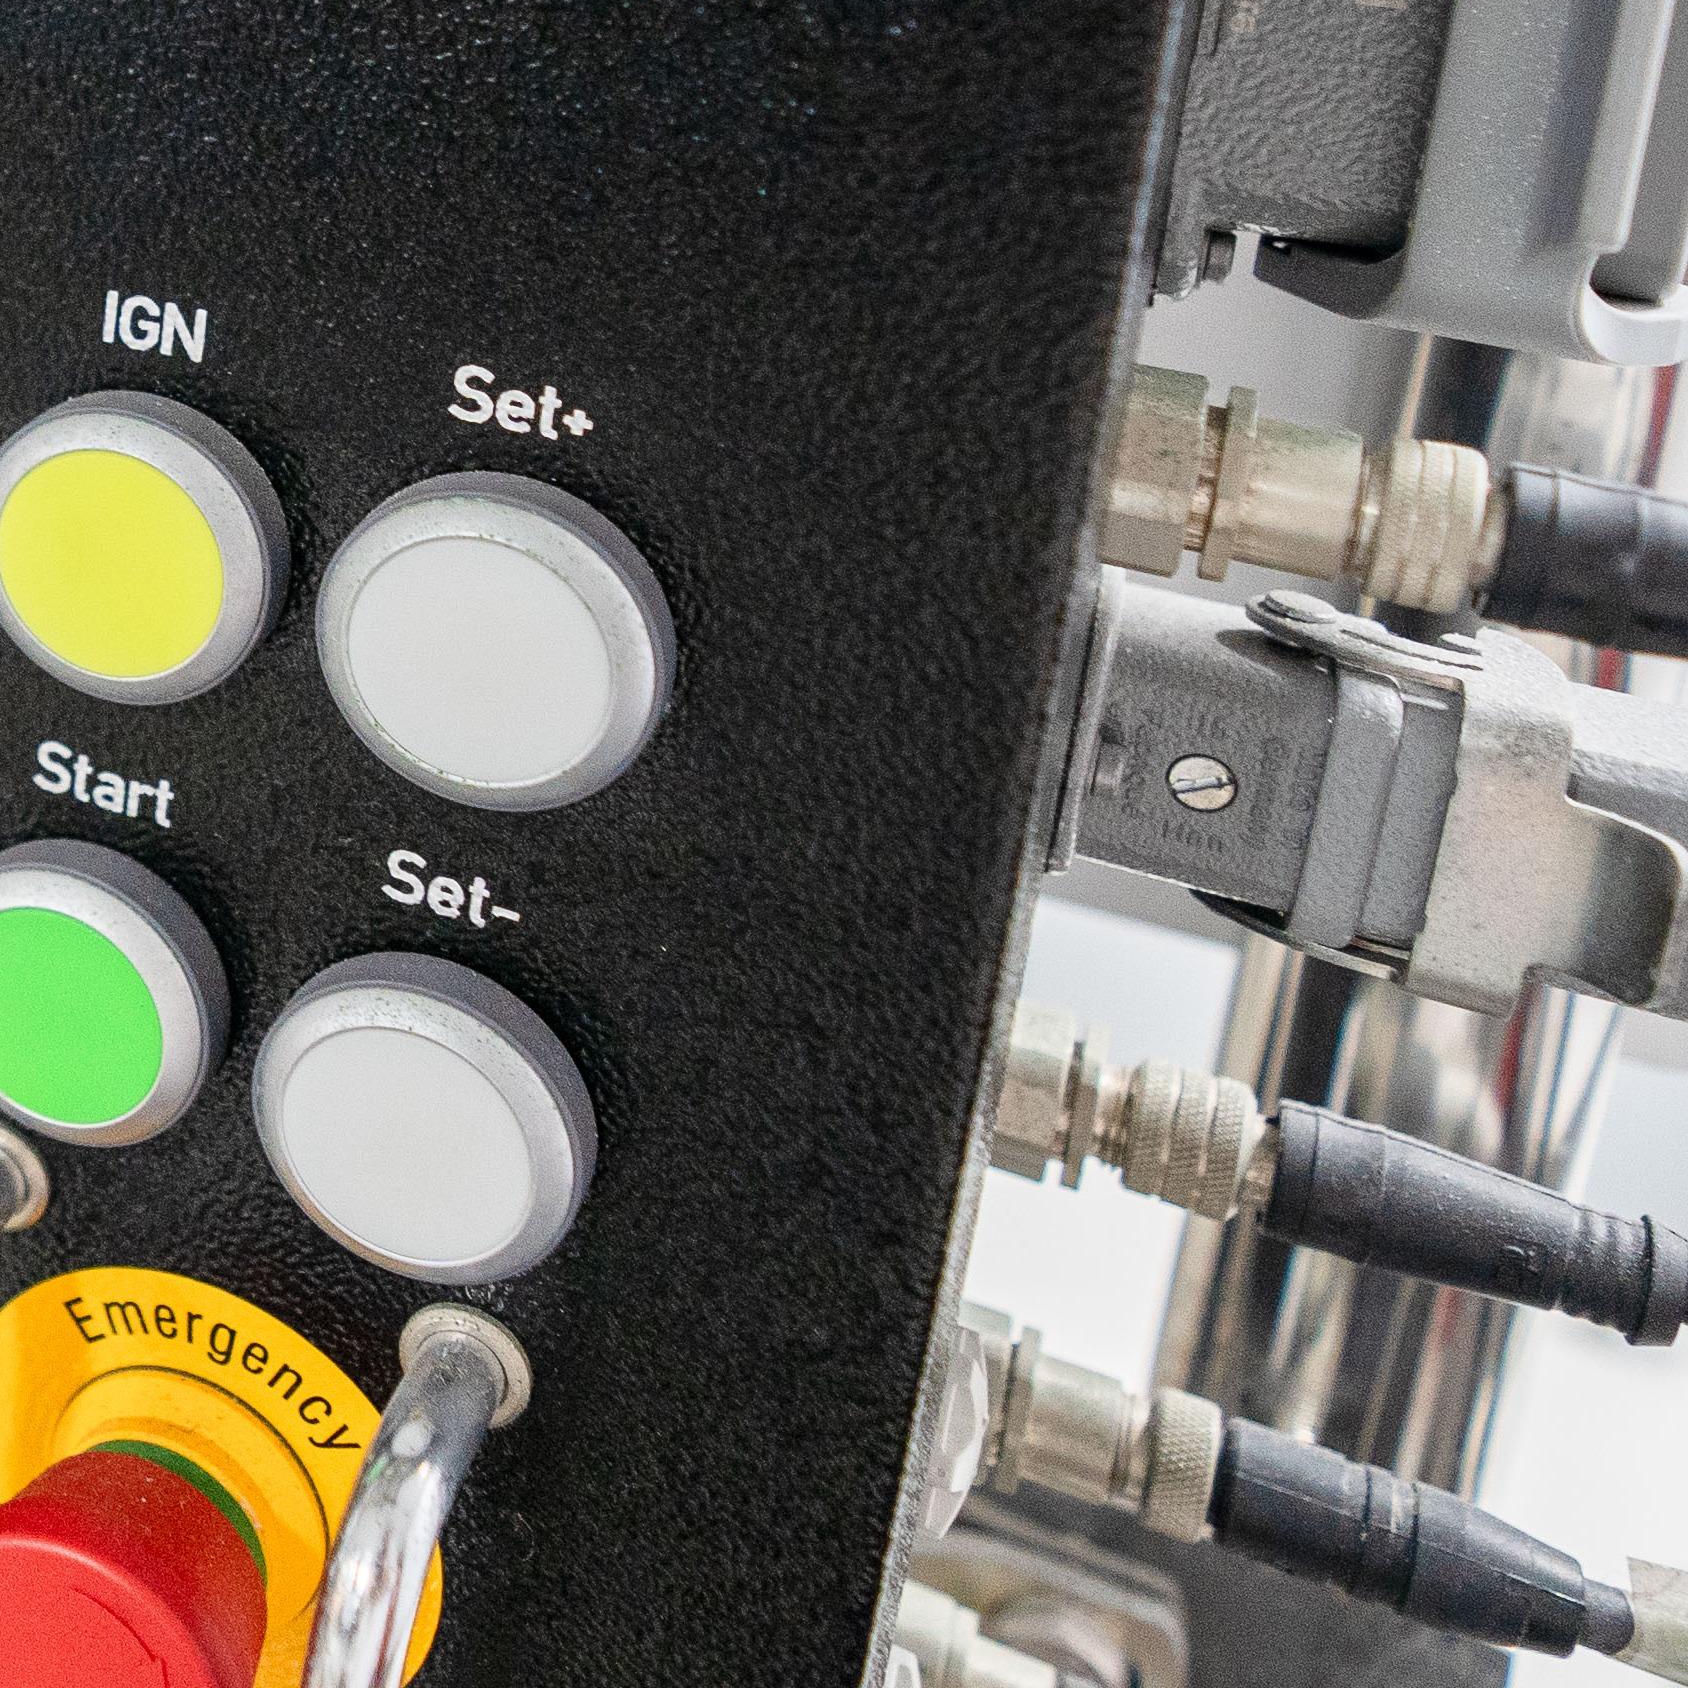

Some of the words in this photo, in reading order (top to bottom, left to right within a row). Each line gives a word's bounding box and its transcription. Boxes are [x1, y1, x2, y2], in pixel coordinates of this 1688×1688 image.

[102, 290, 208, 363] IGN
[447, 363, 594, 440] Set+
[32, 740, 175, 828] Start
[381, 849, 521, 929] Set-
[62, 1296, 363, 1453] Emergency
